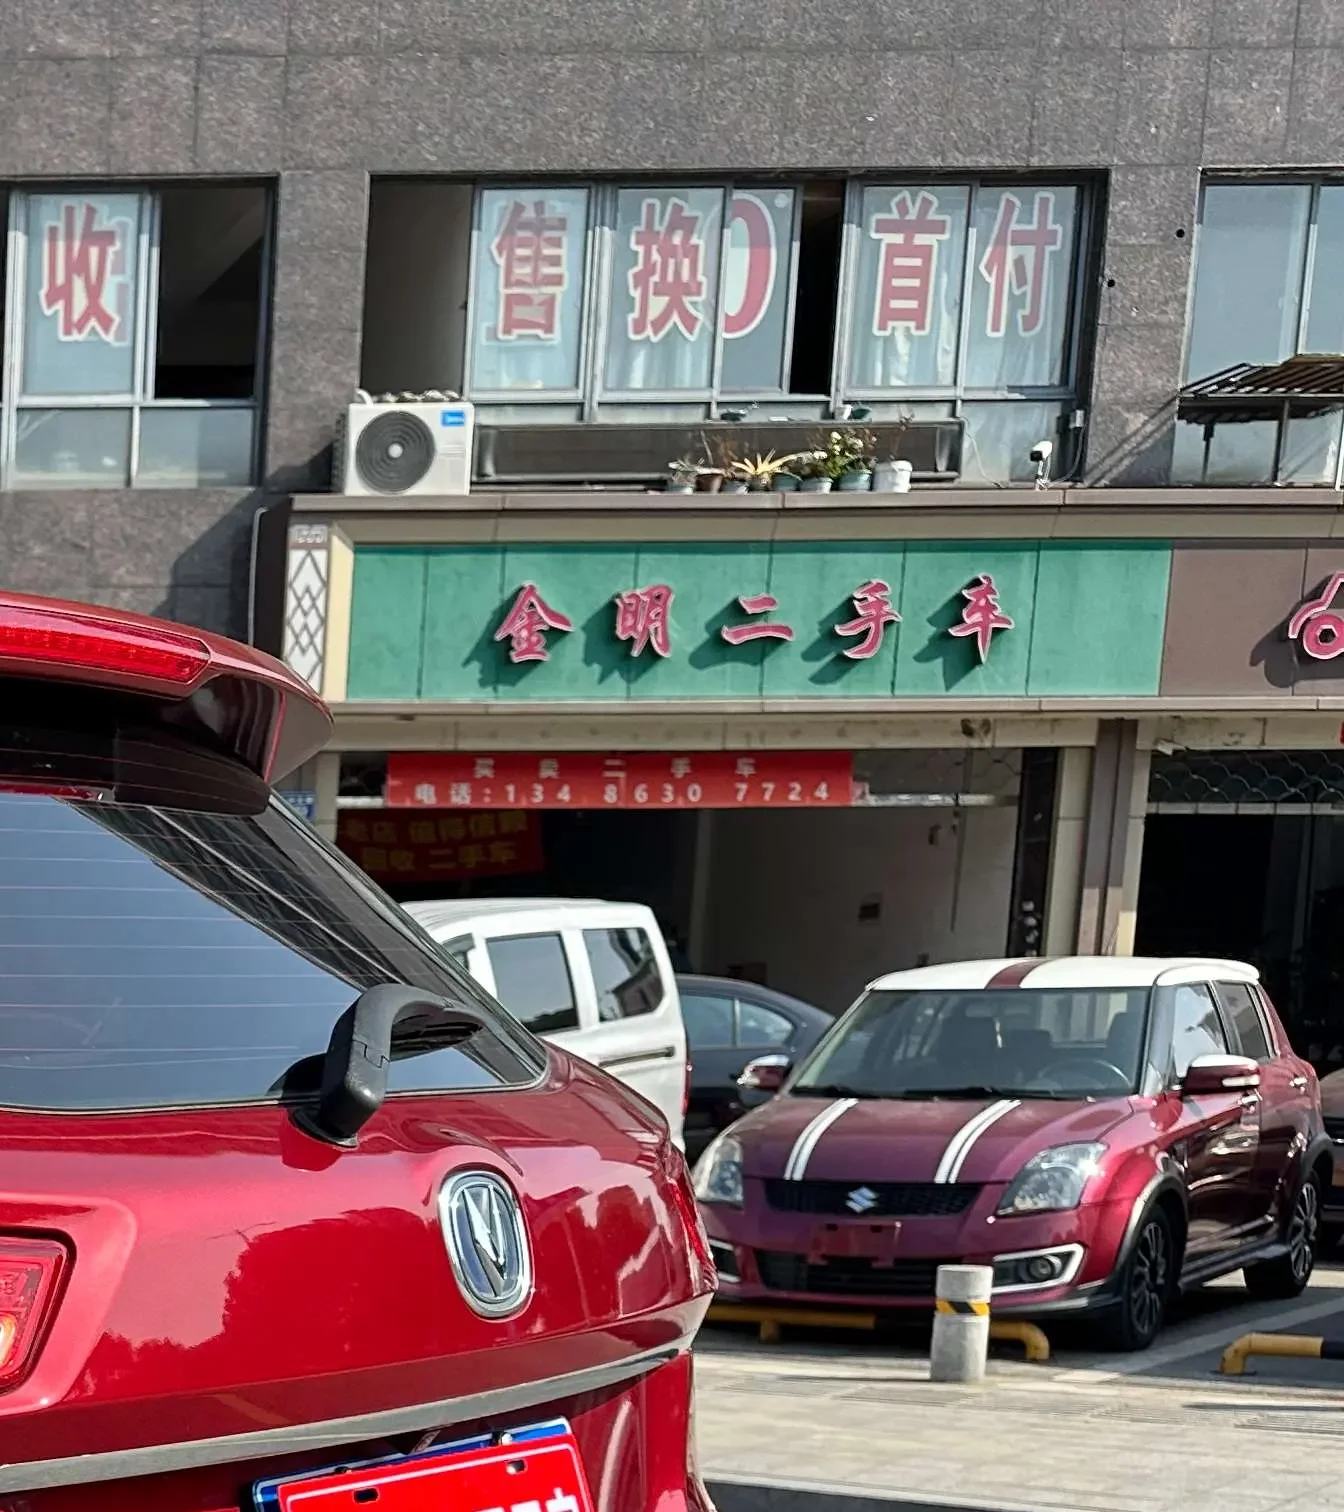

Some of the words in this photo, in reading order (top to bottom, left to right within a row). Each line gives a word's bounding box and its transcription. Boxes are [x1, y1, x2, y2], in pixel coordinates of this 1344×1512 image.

[493, 575, 1014, 664] 金明二手车
[603, 784, 703, 803] 8630
[734, 783, 829, 801] 7724
